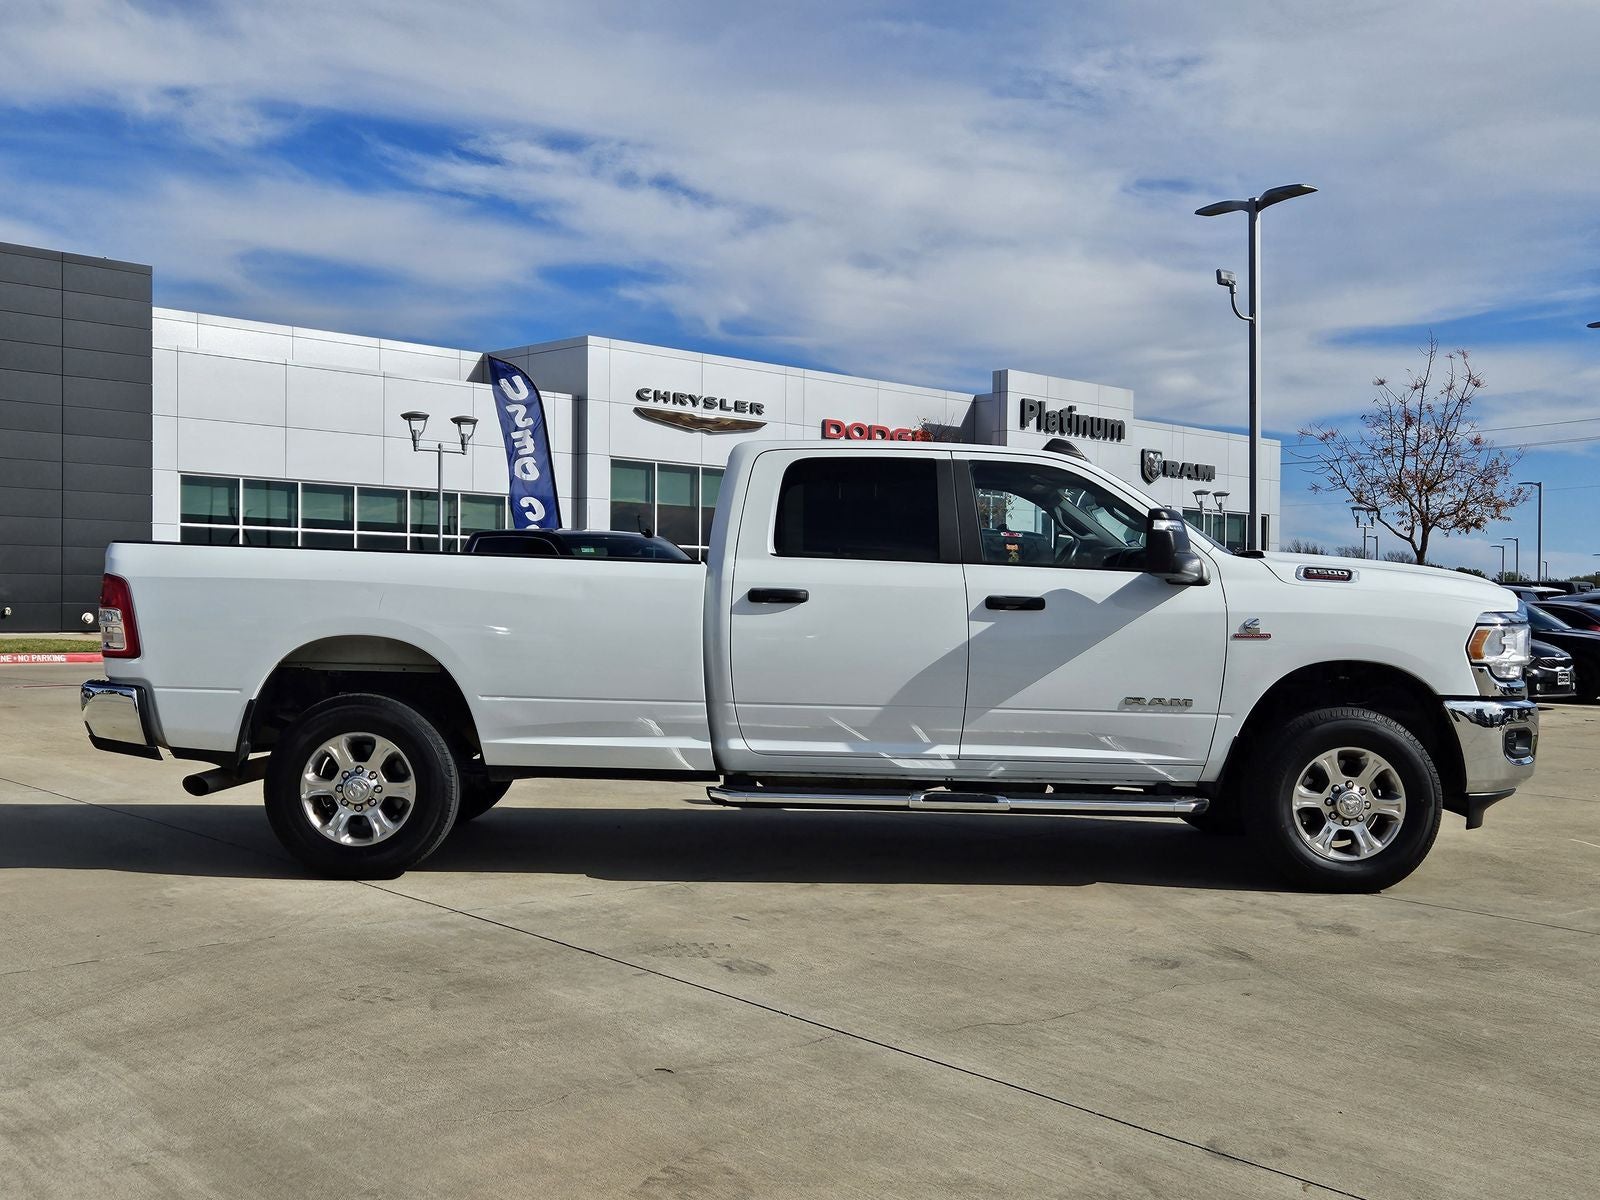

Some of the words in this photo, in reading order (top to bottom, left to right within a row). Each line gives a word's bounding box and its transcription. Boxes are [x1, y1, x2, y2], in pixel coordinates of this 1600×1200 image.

[635, 387, 765, 416] CHRYSLER
[821, 418, 933, 441] DODG
[1020, 398, 1126, 442] Platinum
[1162, 459, 1216, 482] RAM
[1307, 568, 1349, 577] 3500
[17, 654, 30, 662] NO
[31, 654, 66, 662] PARKING
[1124, 696, 1194, 707] RAM
